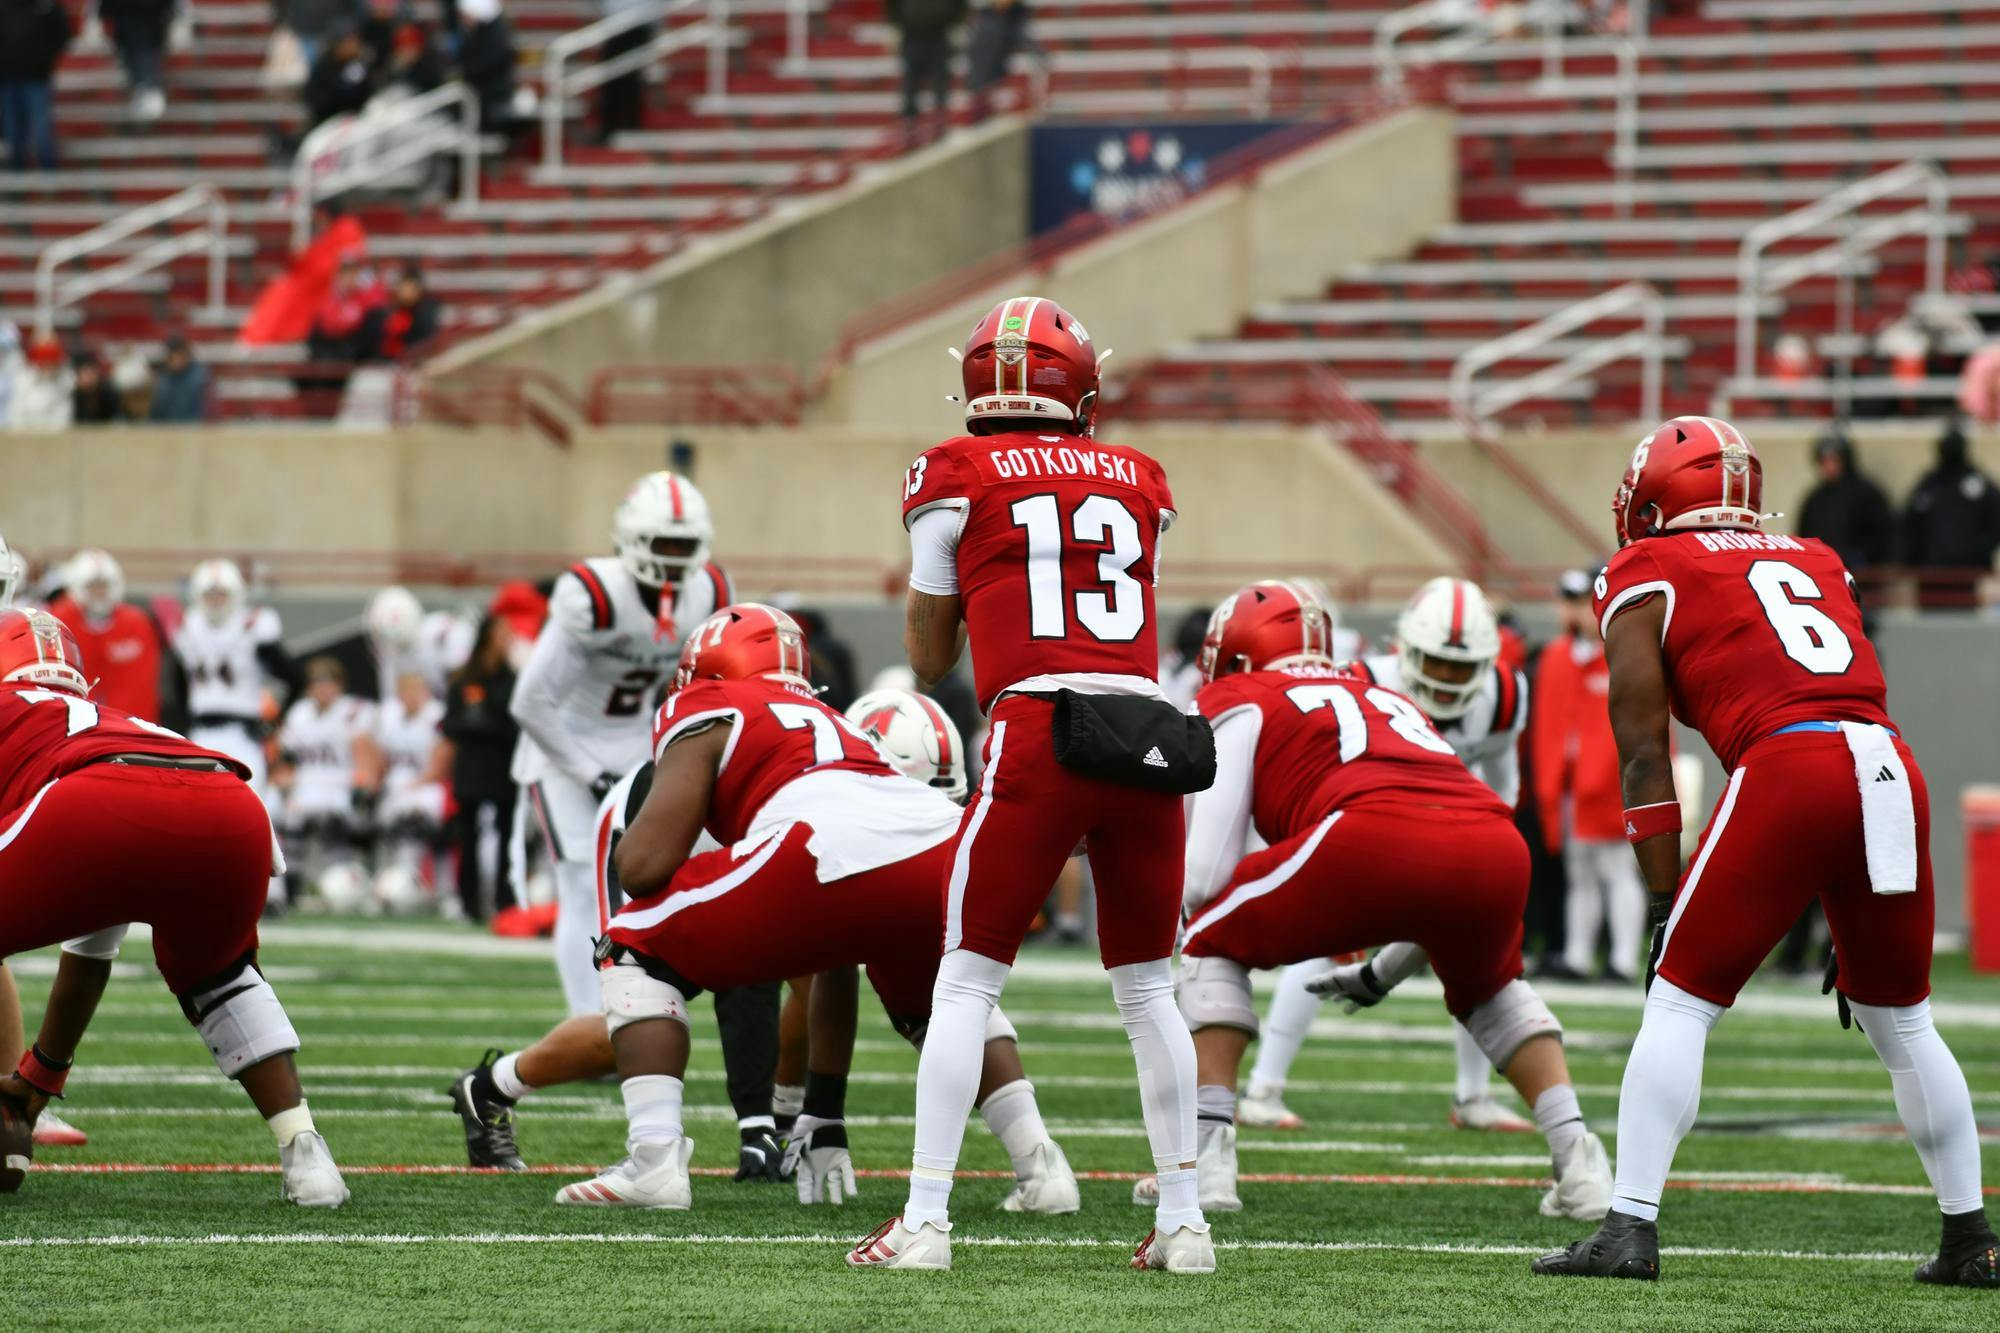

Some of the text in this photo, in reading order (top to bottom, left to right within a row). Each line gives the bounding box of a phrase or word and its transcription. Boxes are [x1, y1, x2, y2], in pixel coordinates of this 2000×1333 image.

[986, 401, 1001, 410] LOVE
[990, 447, 1138, 486] GOTKOWSKI
[1632, 435, 1656, 471] 6
[904, 455, 928, 501] 13
[1717, 512, 1733, 521] LOVE
[1694, 532, 1806, 552] BRUNSON
[1010, 492, 1145, 643] 13
[1594, 566, 1609, 601] 6
[687, 616, 731, 653] 77
[1746, 560, 1854, 675] 6
[1285, 685, 1457, 764] 78
[1143, 757, 1168, 768] adidas
